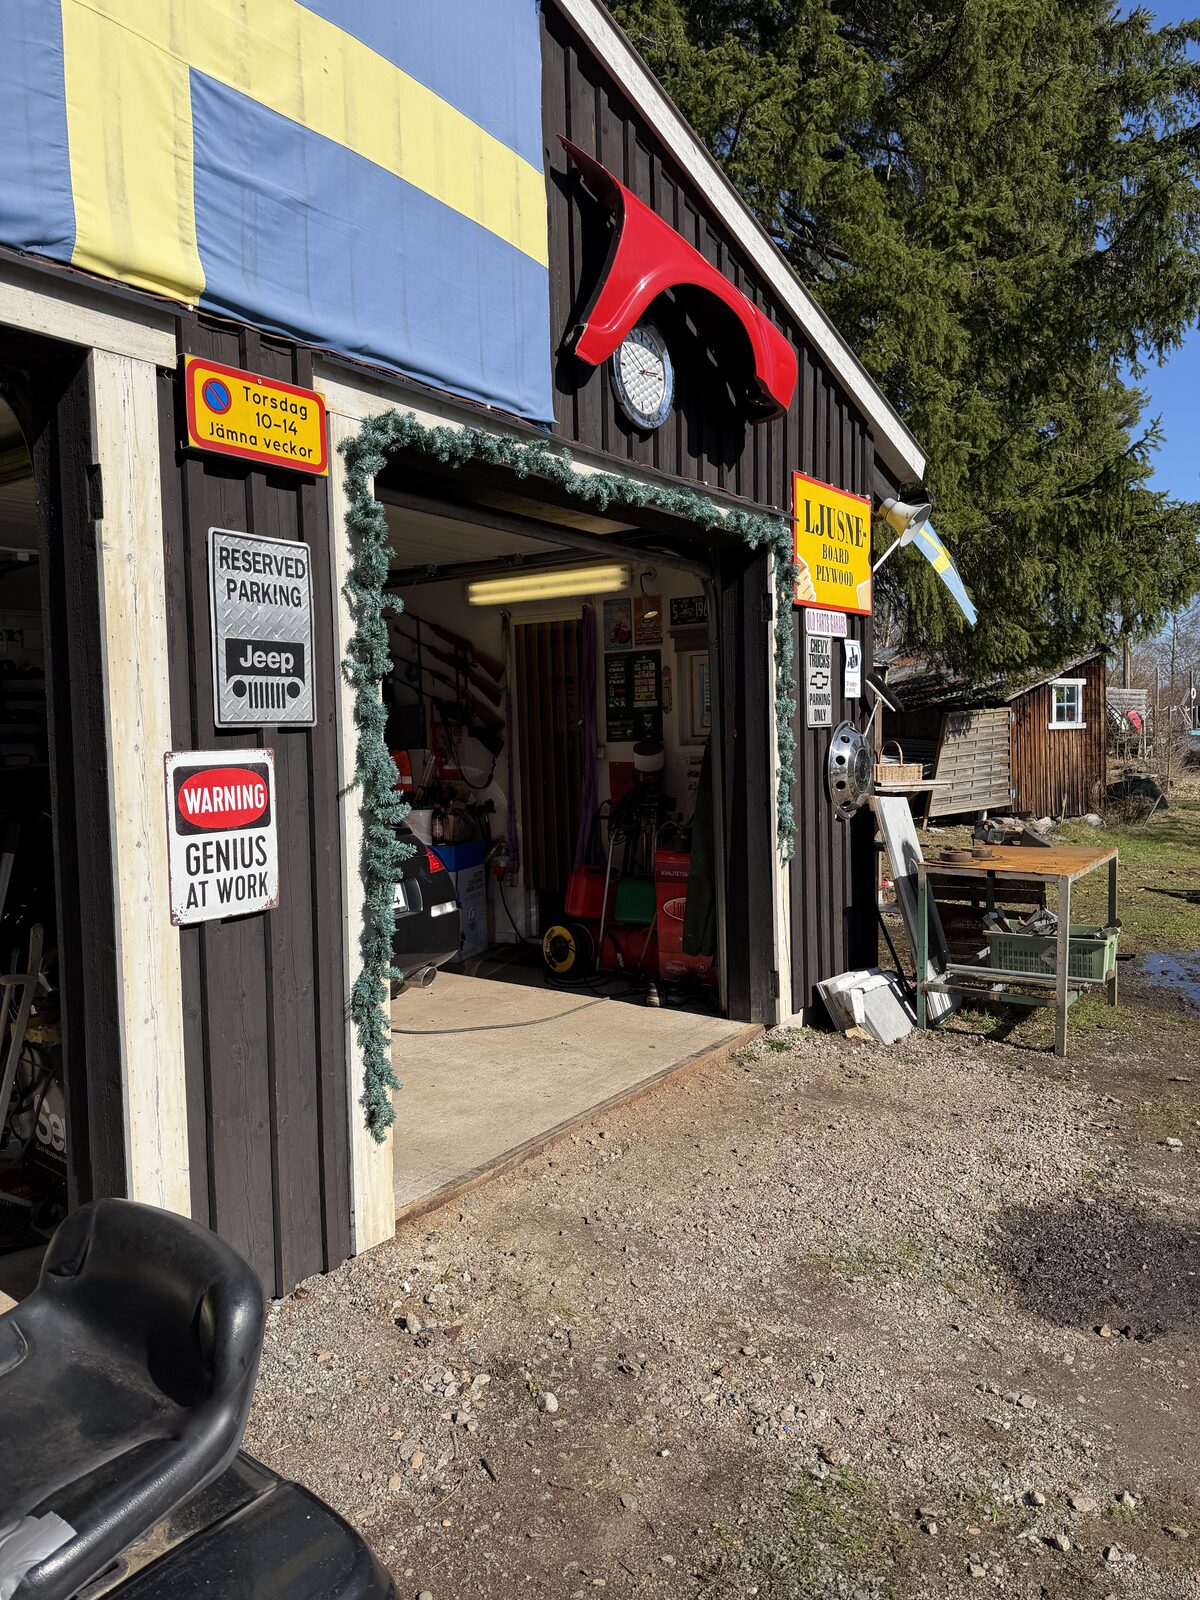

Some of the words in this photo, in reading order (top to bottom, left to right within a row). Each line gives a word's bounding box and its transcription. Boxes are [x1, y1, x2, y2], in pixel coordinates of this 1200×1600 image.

[242, 386, 308, 420] Torsdag
[256, 412, 298, 436] 10-14
[210, 421, 258, 446] Jämna
[264, 437, 313, 458] veckor
[804, 498, 867, 548] LJUSNE-
[219, 546, 306, 579] RESERVED
[822, 543, 849, 565] BOARD
[815, 564, 854, 588] PLYWOOD
[226, 578, 302, 608] PARKING
[807, 610, 816, 631] OLD
[816, 612, 830, 633] FARTS
[830, 614, 846, 635] GARAGE
[239, 644, 294, 674] Jeep
[808, 652, 830, 668] TRUCKS
[810, 638, 829, 654] CHEVY
[809, 692, 831, 706] PARKING
[812, 707, 827, 722] ONLY
[183, 784, 265, 814] WARNING
[185, 834, 268, 876] GENIUS
[186, 880, 209, 910] AT
[216, 871, 268, 904] WORK
[34, 1094, 68, 1154] Se
